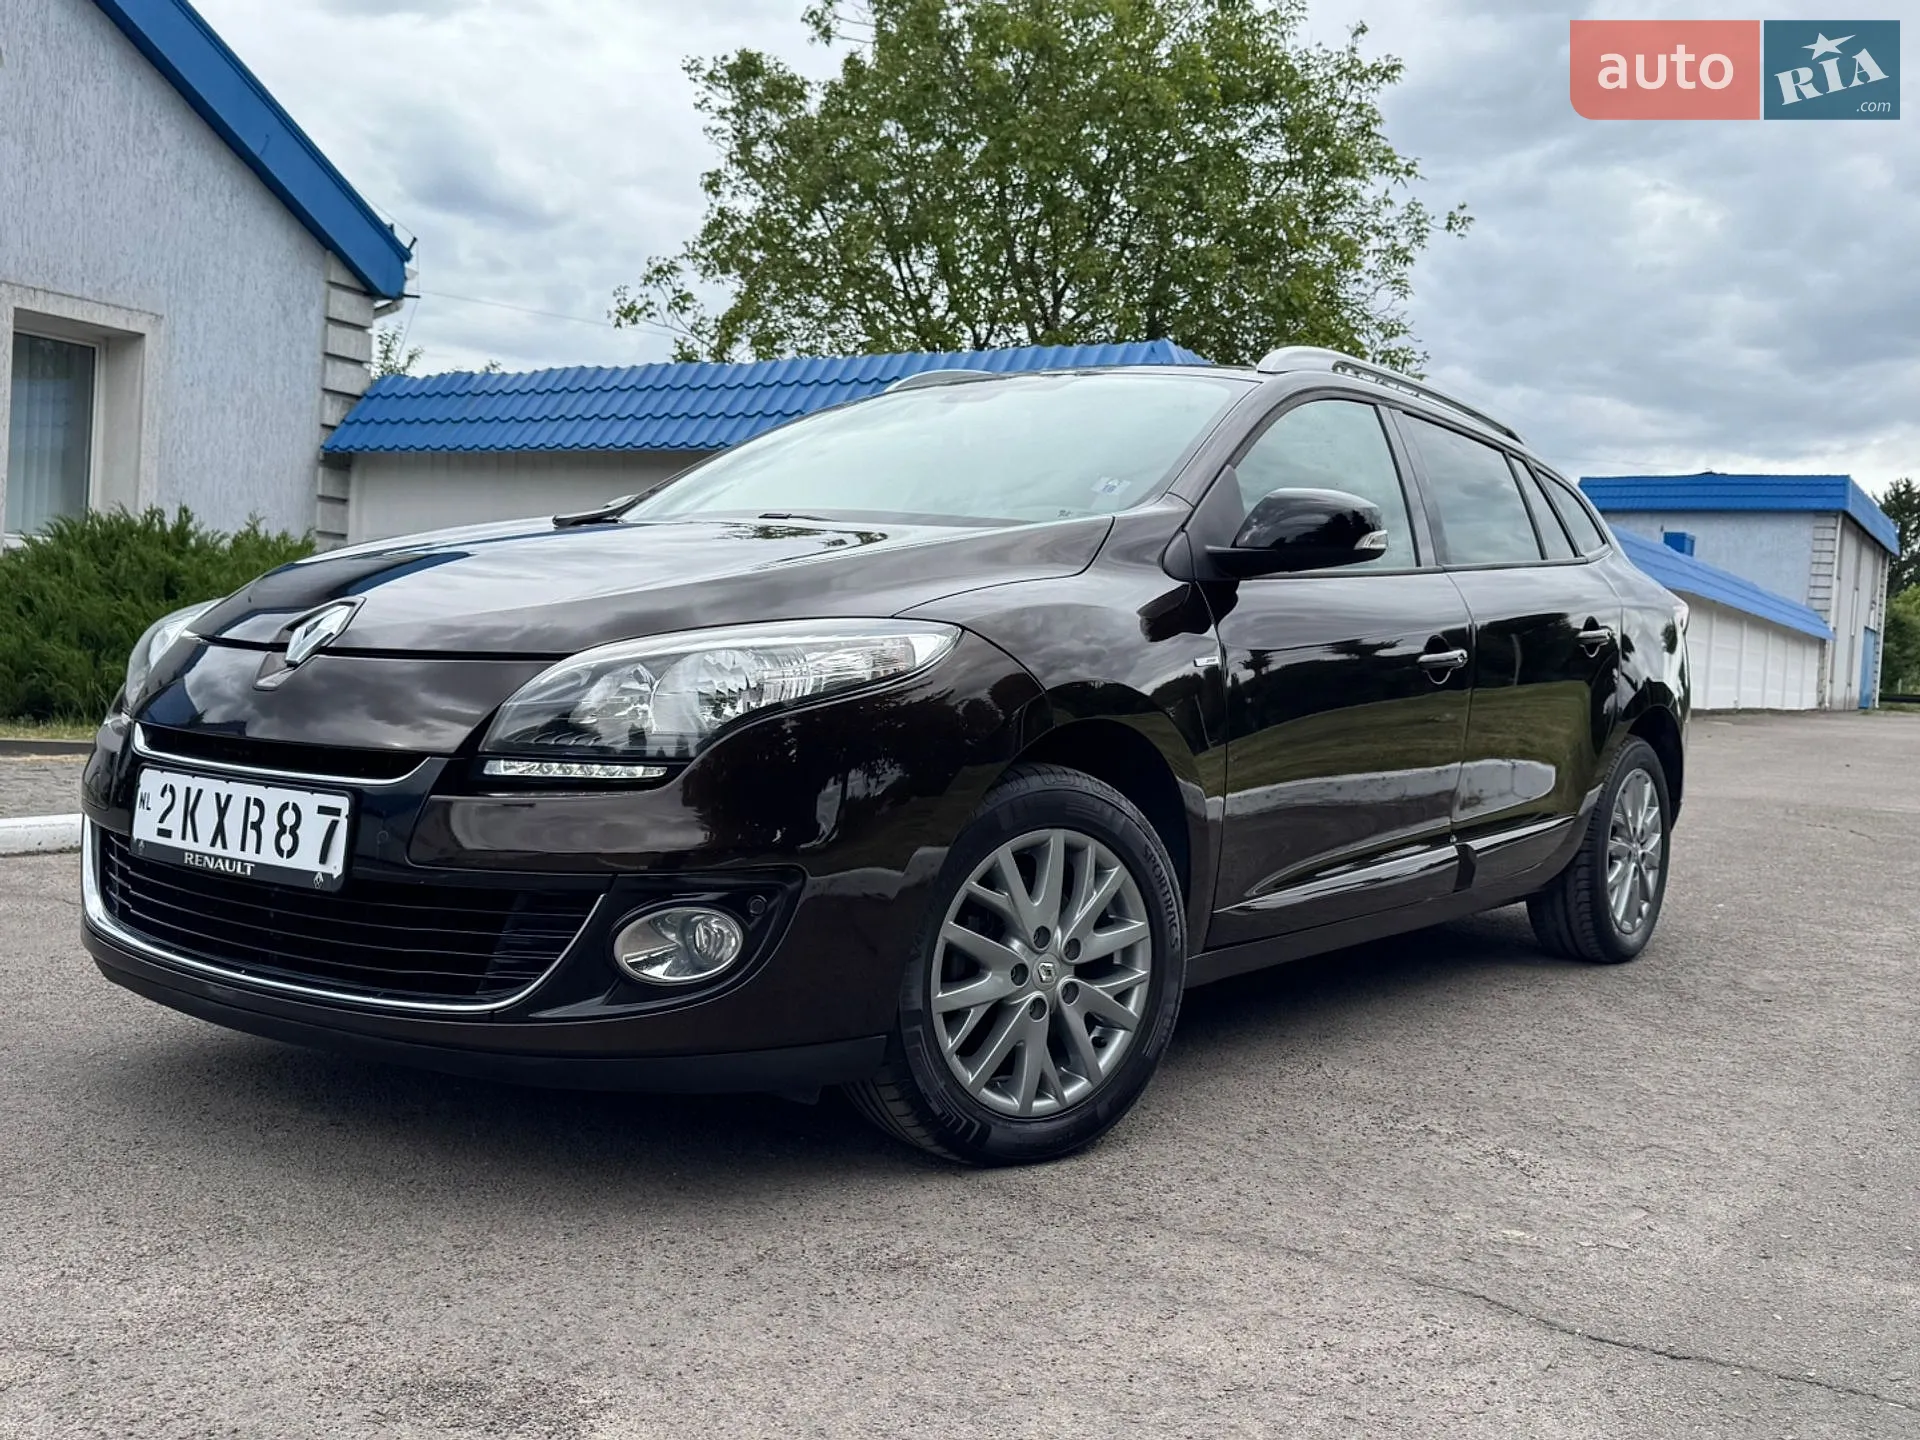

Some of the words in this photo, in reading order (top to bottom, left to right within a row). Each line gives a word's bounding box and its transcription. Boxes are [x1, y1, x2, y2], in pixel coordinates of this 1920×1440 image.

[138, 790, 152, 811] NL
[156, 783, 342, 865] 2KXR87
[184, 851, 255, 877] RENAULT
